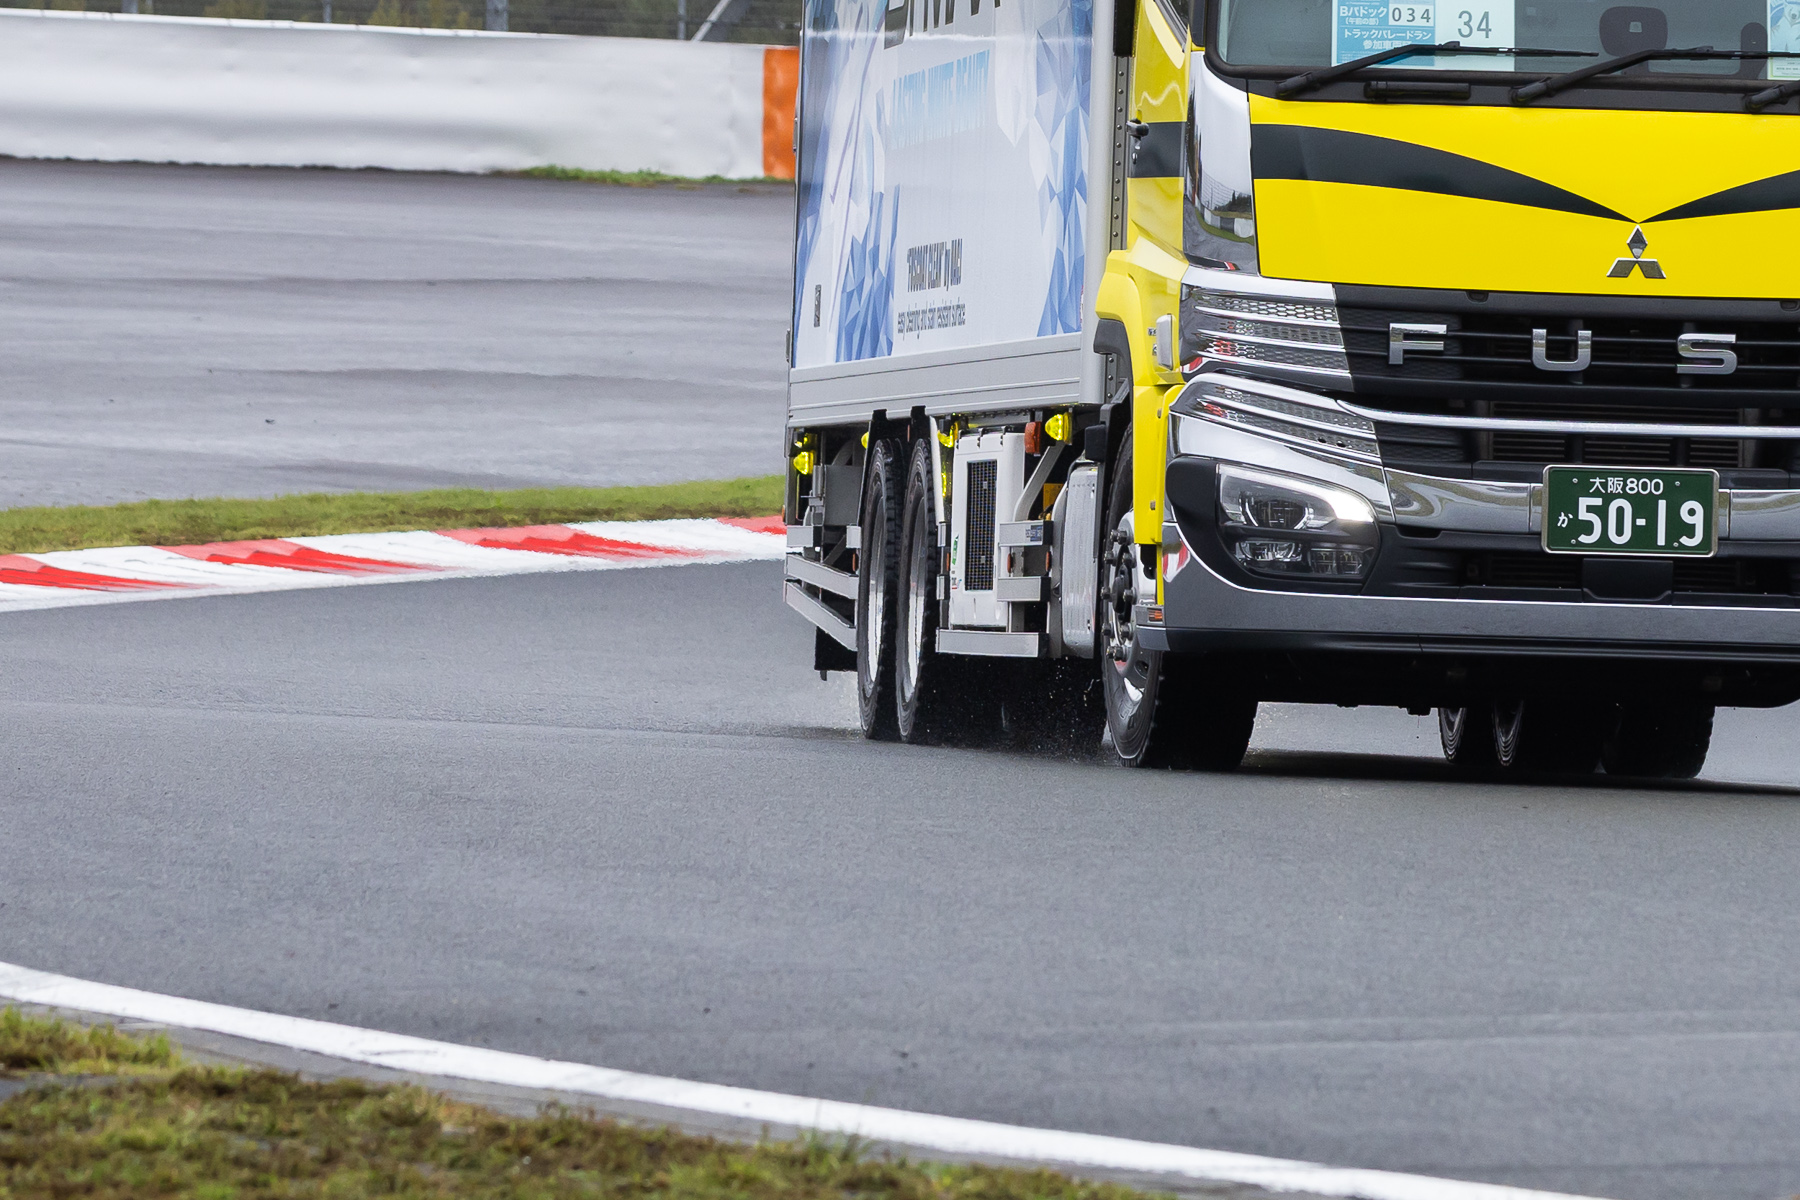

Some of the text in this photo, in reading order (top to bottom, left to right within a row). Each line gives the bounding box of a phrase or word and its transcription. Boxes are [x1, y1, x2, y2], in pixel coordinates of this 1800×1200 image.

[1392, 7, 1432, 23] 034
[1457, 10, 1492, 39] 34
[1557, 497, 1704, 547] か 50-19
